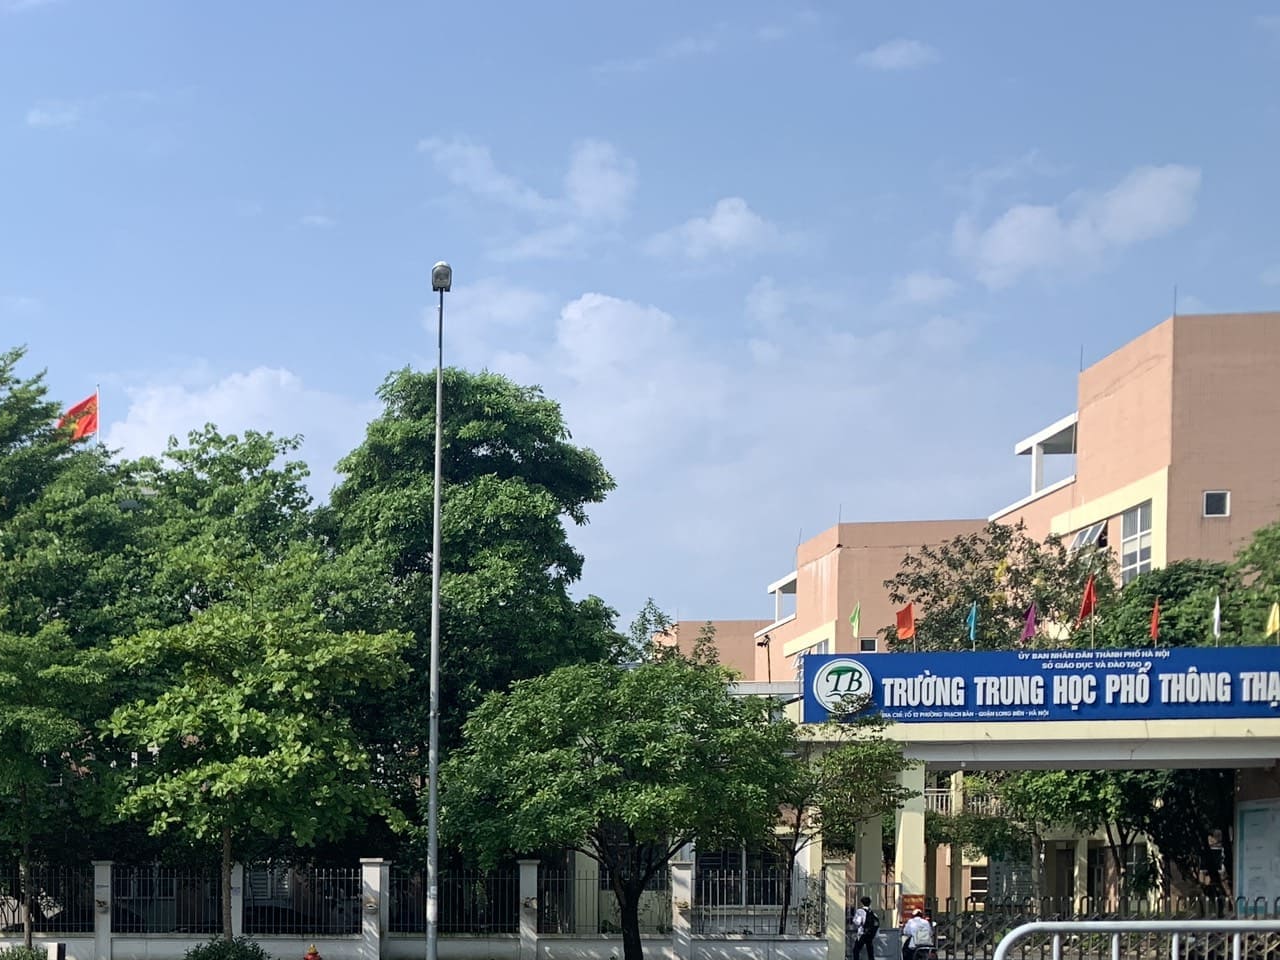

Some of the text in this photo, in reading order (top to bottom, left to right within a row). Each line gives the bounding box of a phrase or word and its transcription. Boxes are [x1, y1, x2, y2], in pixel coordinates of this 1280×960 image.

[1050, 651, 1073, 659] NHÂN
[1075, 651, 1093, 659] DÂN
[1095, 650, 1122, 658] THÀNH
[1124, 649, 1140, 658] PHỐ
[1155, 650, 1170, 659] NỘI
[1055, 661, 1074, 669] GIÁO
[1076, 662, 1093, 670] DỤC
[1126, 661, 1142, 669] TẠO
[882, 670, 965, 707] TRƯỜNG
[973, 675, 1044, 706] TRUNG
[1053, 674, 1096, 711] HỌC
[1105, 661, 1151, 704] PHỔ
[1158, 666, 1231, 703] THÔNG
